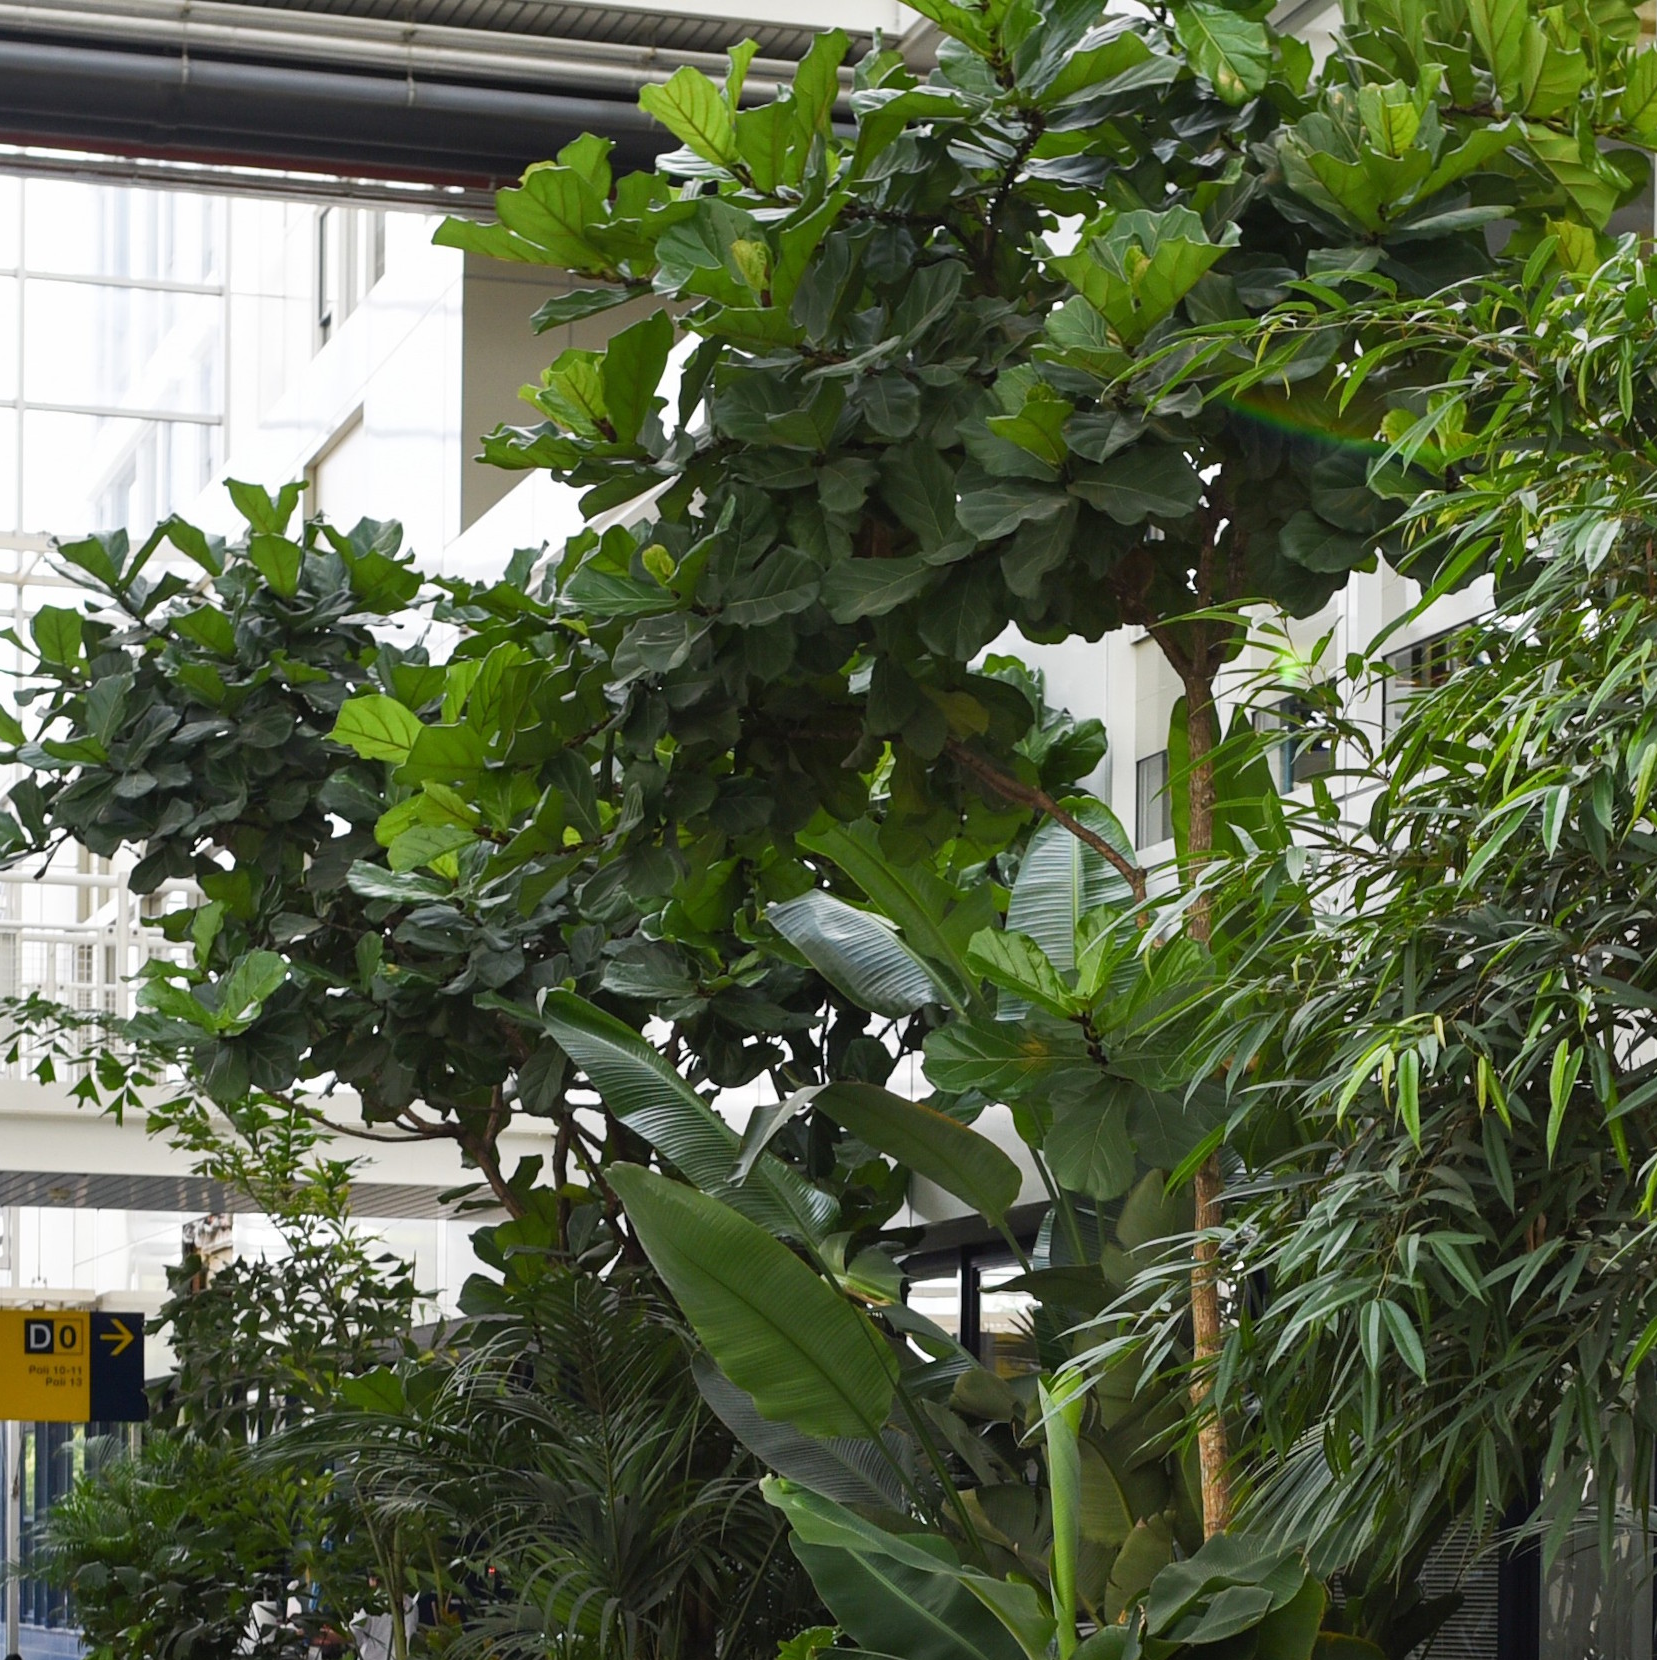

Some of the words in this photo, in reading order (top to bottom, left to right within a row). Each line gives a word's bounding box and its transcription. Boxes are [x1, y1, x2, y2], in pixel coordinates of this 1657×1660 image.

[28, 1365, 50, 1376] Poli
[53, 1366, 83, 1376] 10-11
[45, 1377, 67, 1388] Poli
[69, 1378, 83, 1388] 13
